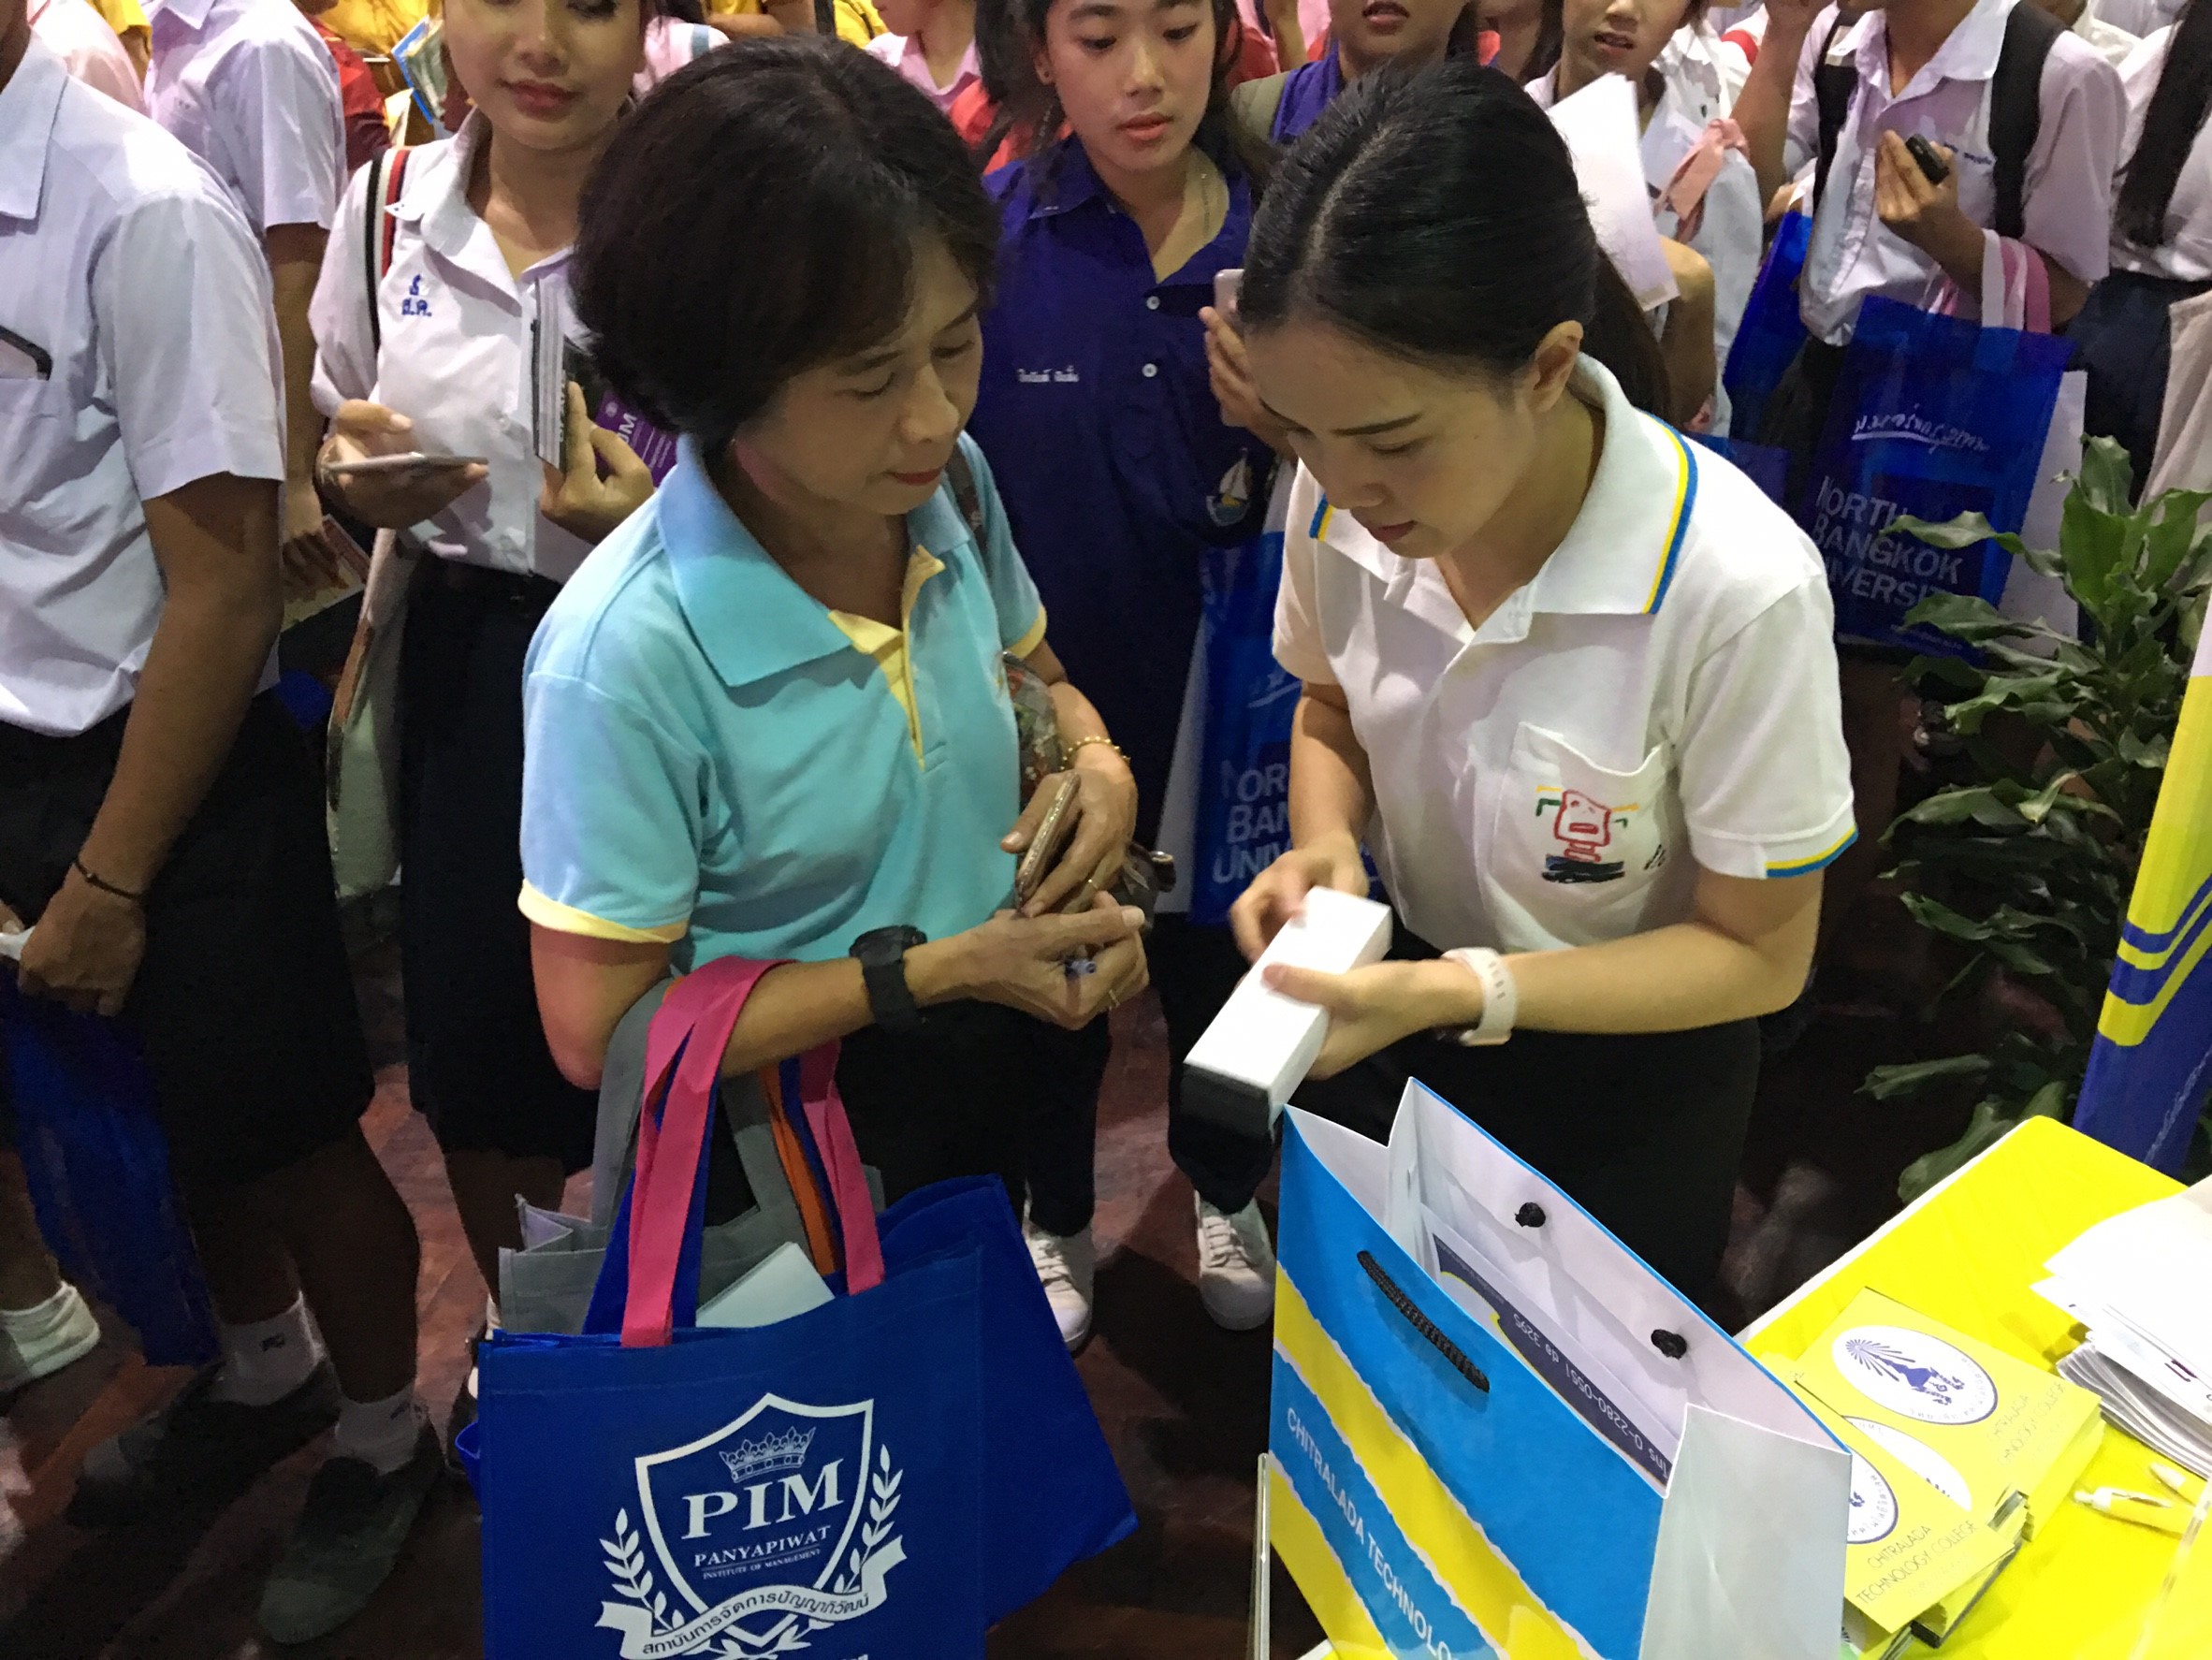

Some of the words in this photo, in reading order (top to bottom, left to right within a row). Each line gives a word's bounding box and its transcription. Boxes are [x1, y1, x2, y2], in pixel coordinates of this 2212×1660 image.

[1812, 517, 1963, 584] BANGKOK
[681, 1458, 844, 1539] PIM
[694, 1525, 831, 1567] PANYAPIWAT
[1287, 1407, 1364, 1545] CHITRALADA
[1367, 1532, 1452, 1660] TECHNOLO
[1867, 1525, 1931, 1569] CHITRALADA
[704, 1565, 747, 1580] INSTITUTE
[750, 1564, 762, 1572] OF
[764, 1549, 821, 1567] MANAGEMENT
[1855, 1551, 1932, 1604] TECHNOLOGY
